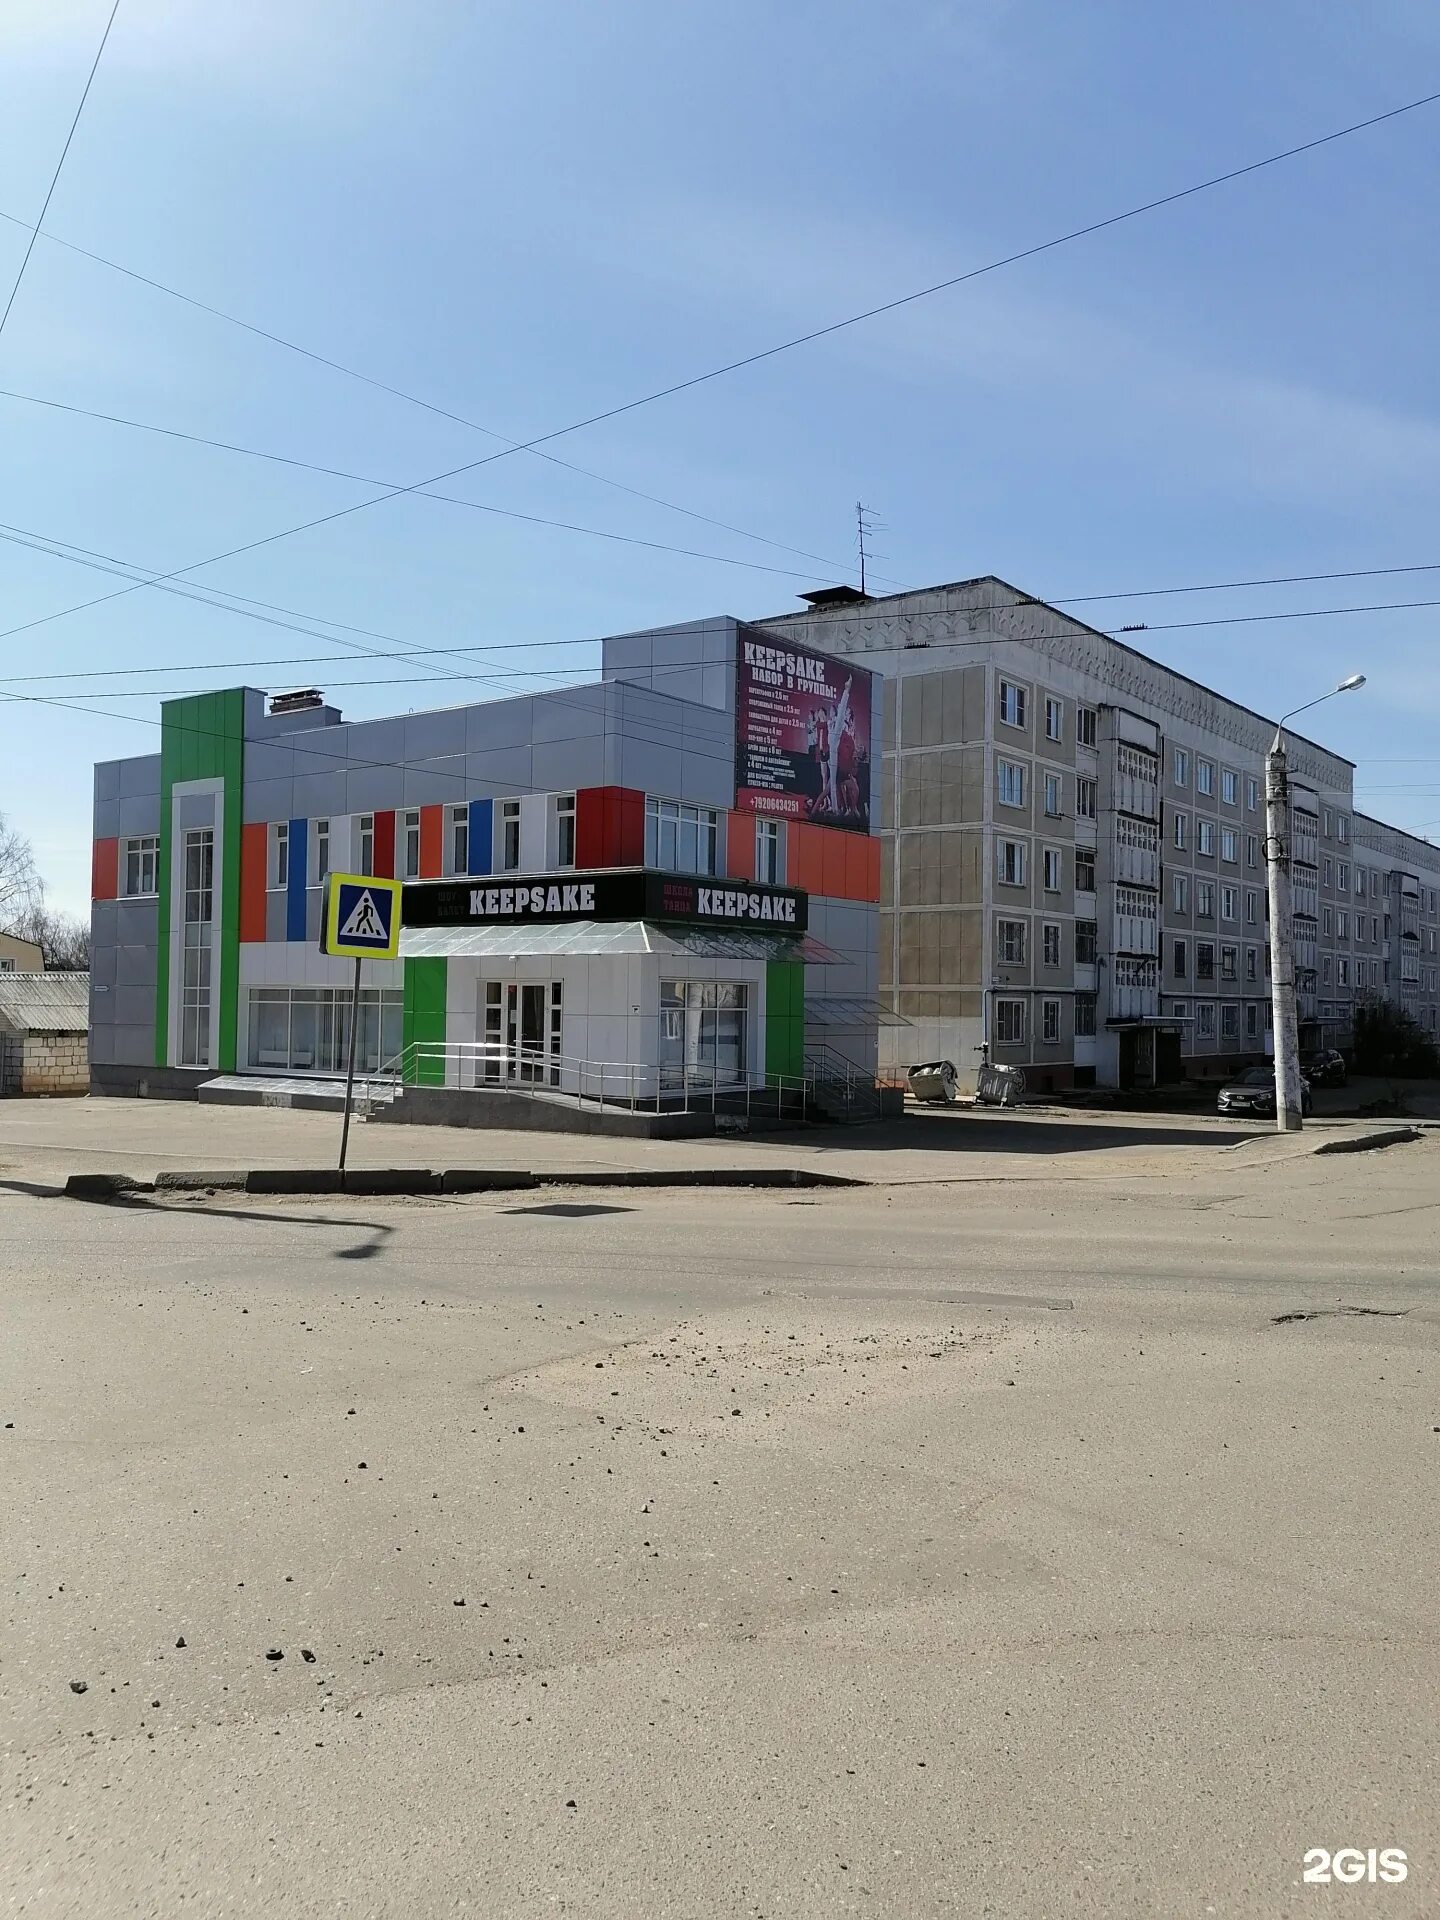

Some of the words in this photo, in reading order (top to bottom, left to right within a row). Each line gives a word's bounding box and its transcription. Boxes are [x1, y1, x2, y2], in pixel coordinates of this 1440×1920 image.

[744, 642, 824, 682] KEEPSAKE
[752, 666, 783, 686] НАБОР
[787, 675, 793, 688] В
[798, 678, 836, 700] ГРУППЫ:
[750, 796, 799, 813] +79206434251
[470, 884, 595, 915] KEEPSAKE
[663, 884, 693, 898] ШКОЛА
[664, 899, 691, 913] ТАНЦА
[698, 888, 796, 922] KEEPSAKE
